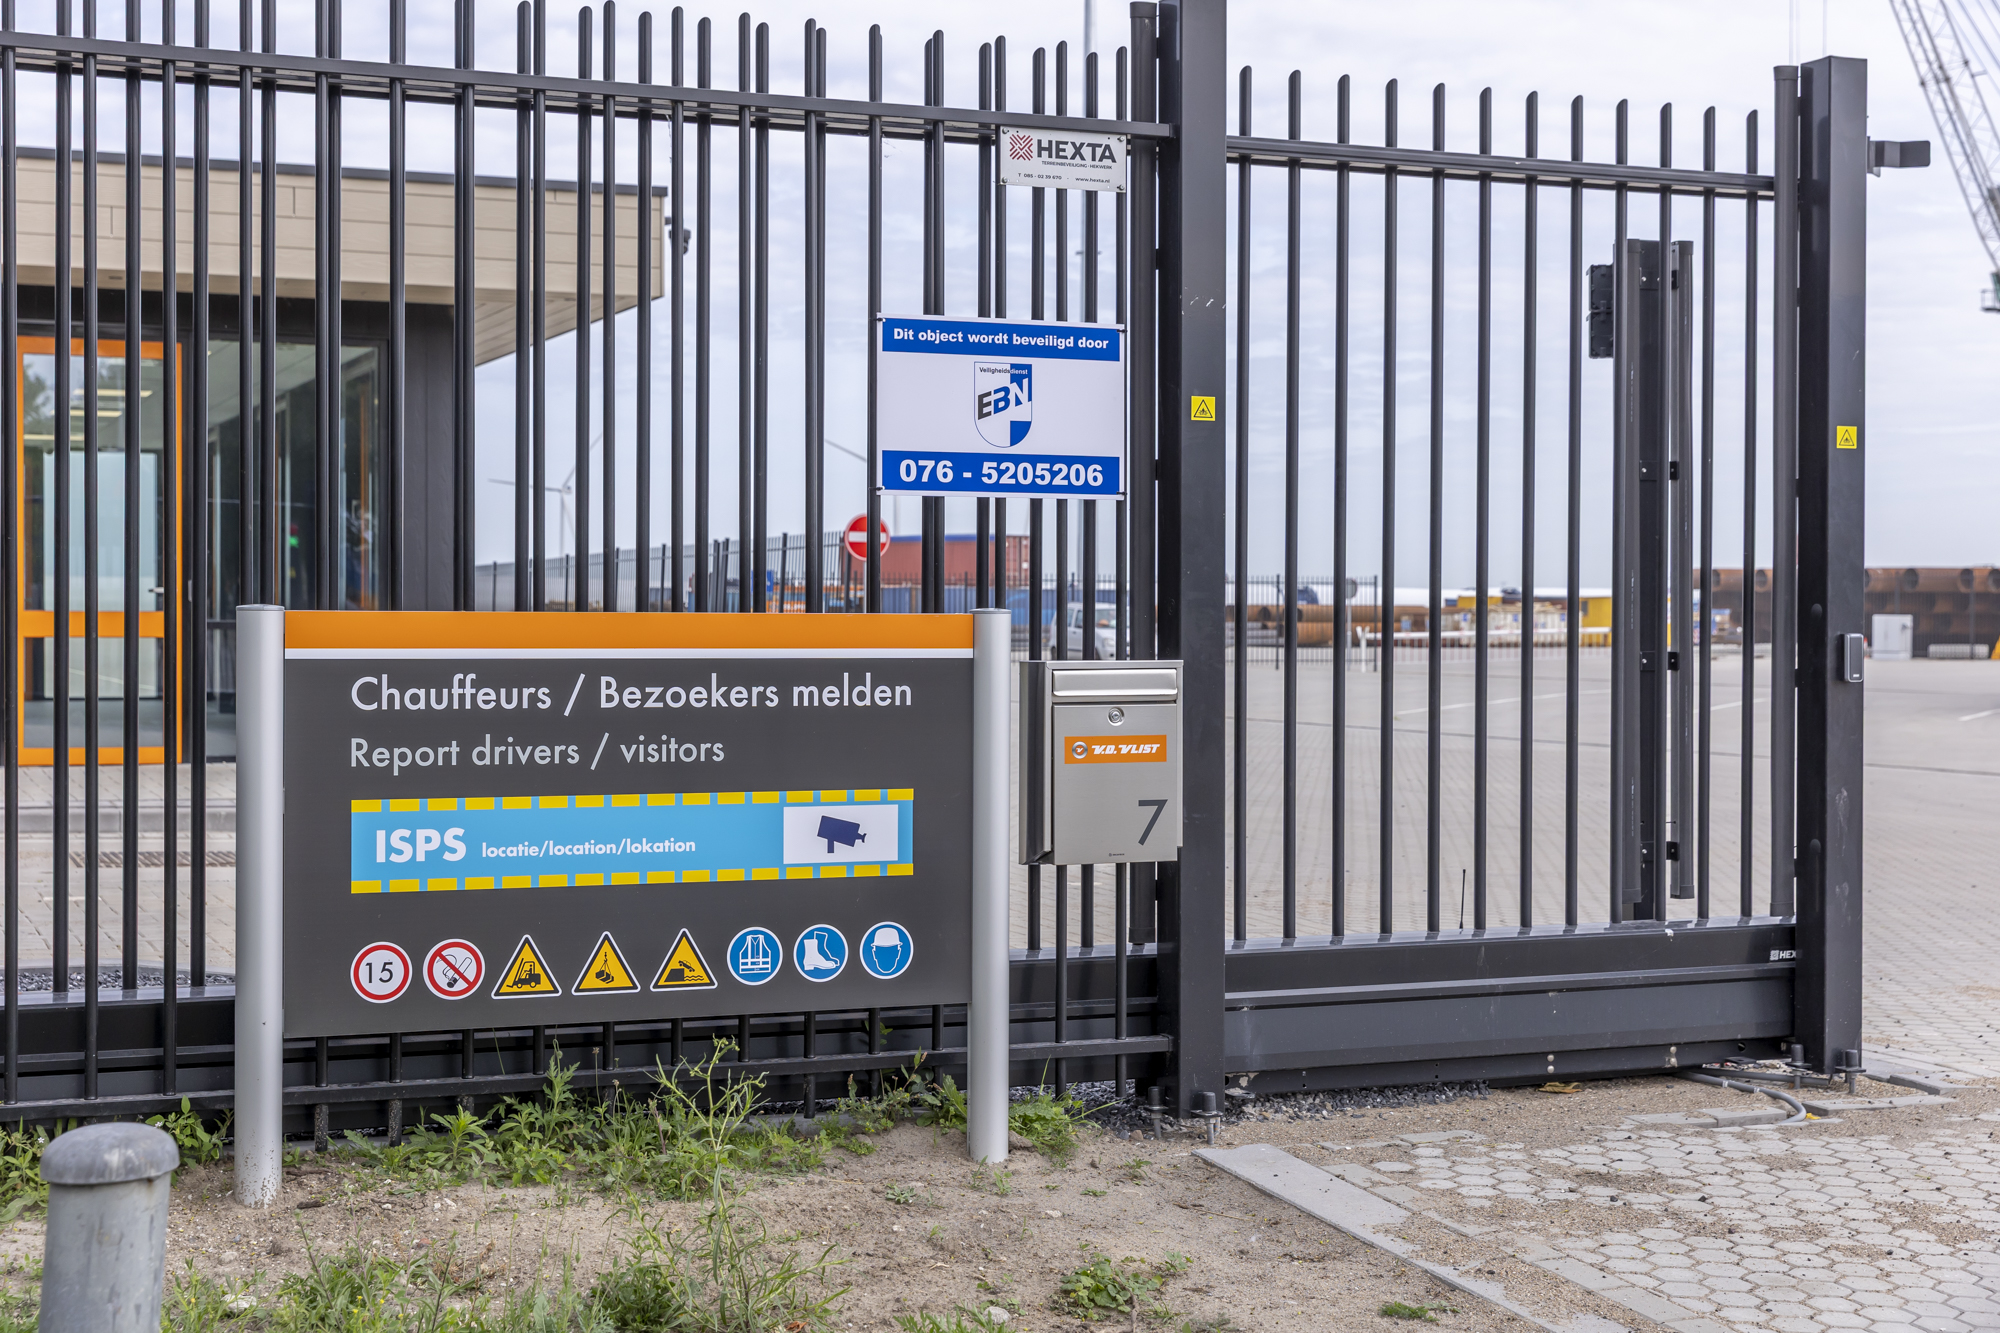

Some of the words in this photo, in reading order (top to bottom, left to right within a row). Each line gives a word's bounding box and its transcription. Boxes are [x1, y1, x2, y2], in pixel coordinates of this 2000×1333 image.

[1037, 139, 1117, 163] HEXTA
[893, 328, 914, 341] Dit
[918, 330, 964, 344] object
[968, 332, 1009, 345] wordt
[1012, 334, 1074, 349] beveiligd
[1077, 336, 1109, 349] door
[979, 367, 1028, 375] Veiligheidsdienst
[977, 377, 1029, 420] EBN
[900, 459, 954, 483] 076
[981, 461, 1104, 487] 5205206
[351, 673, 552, 711] Chauffeurs
[563, 673, 585, 717] /
[600, 672, 780, 709] Bezoekers
[793, 672, 912, 708] melden
[350, 737, 460, 776] Report
[471, 734, 580, 765] drivers
[590, 732, 609, 771] /
[620, 735, 725, 763] visitors
[1091, 744, 1118, 755] V.D.
[1118, 743, 1161, 754] VLIST
[1138, 799, 1168, 846] 7
[375, 827, 467, 864] ISPS
[481, 837, 696, 860] locatie/location/lokation
[365, 961, 394, 984] 15
